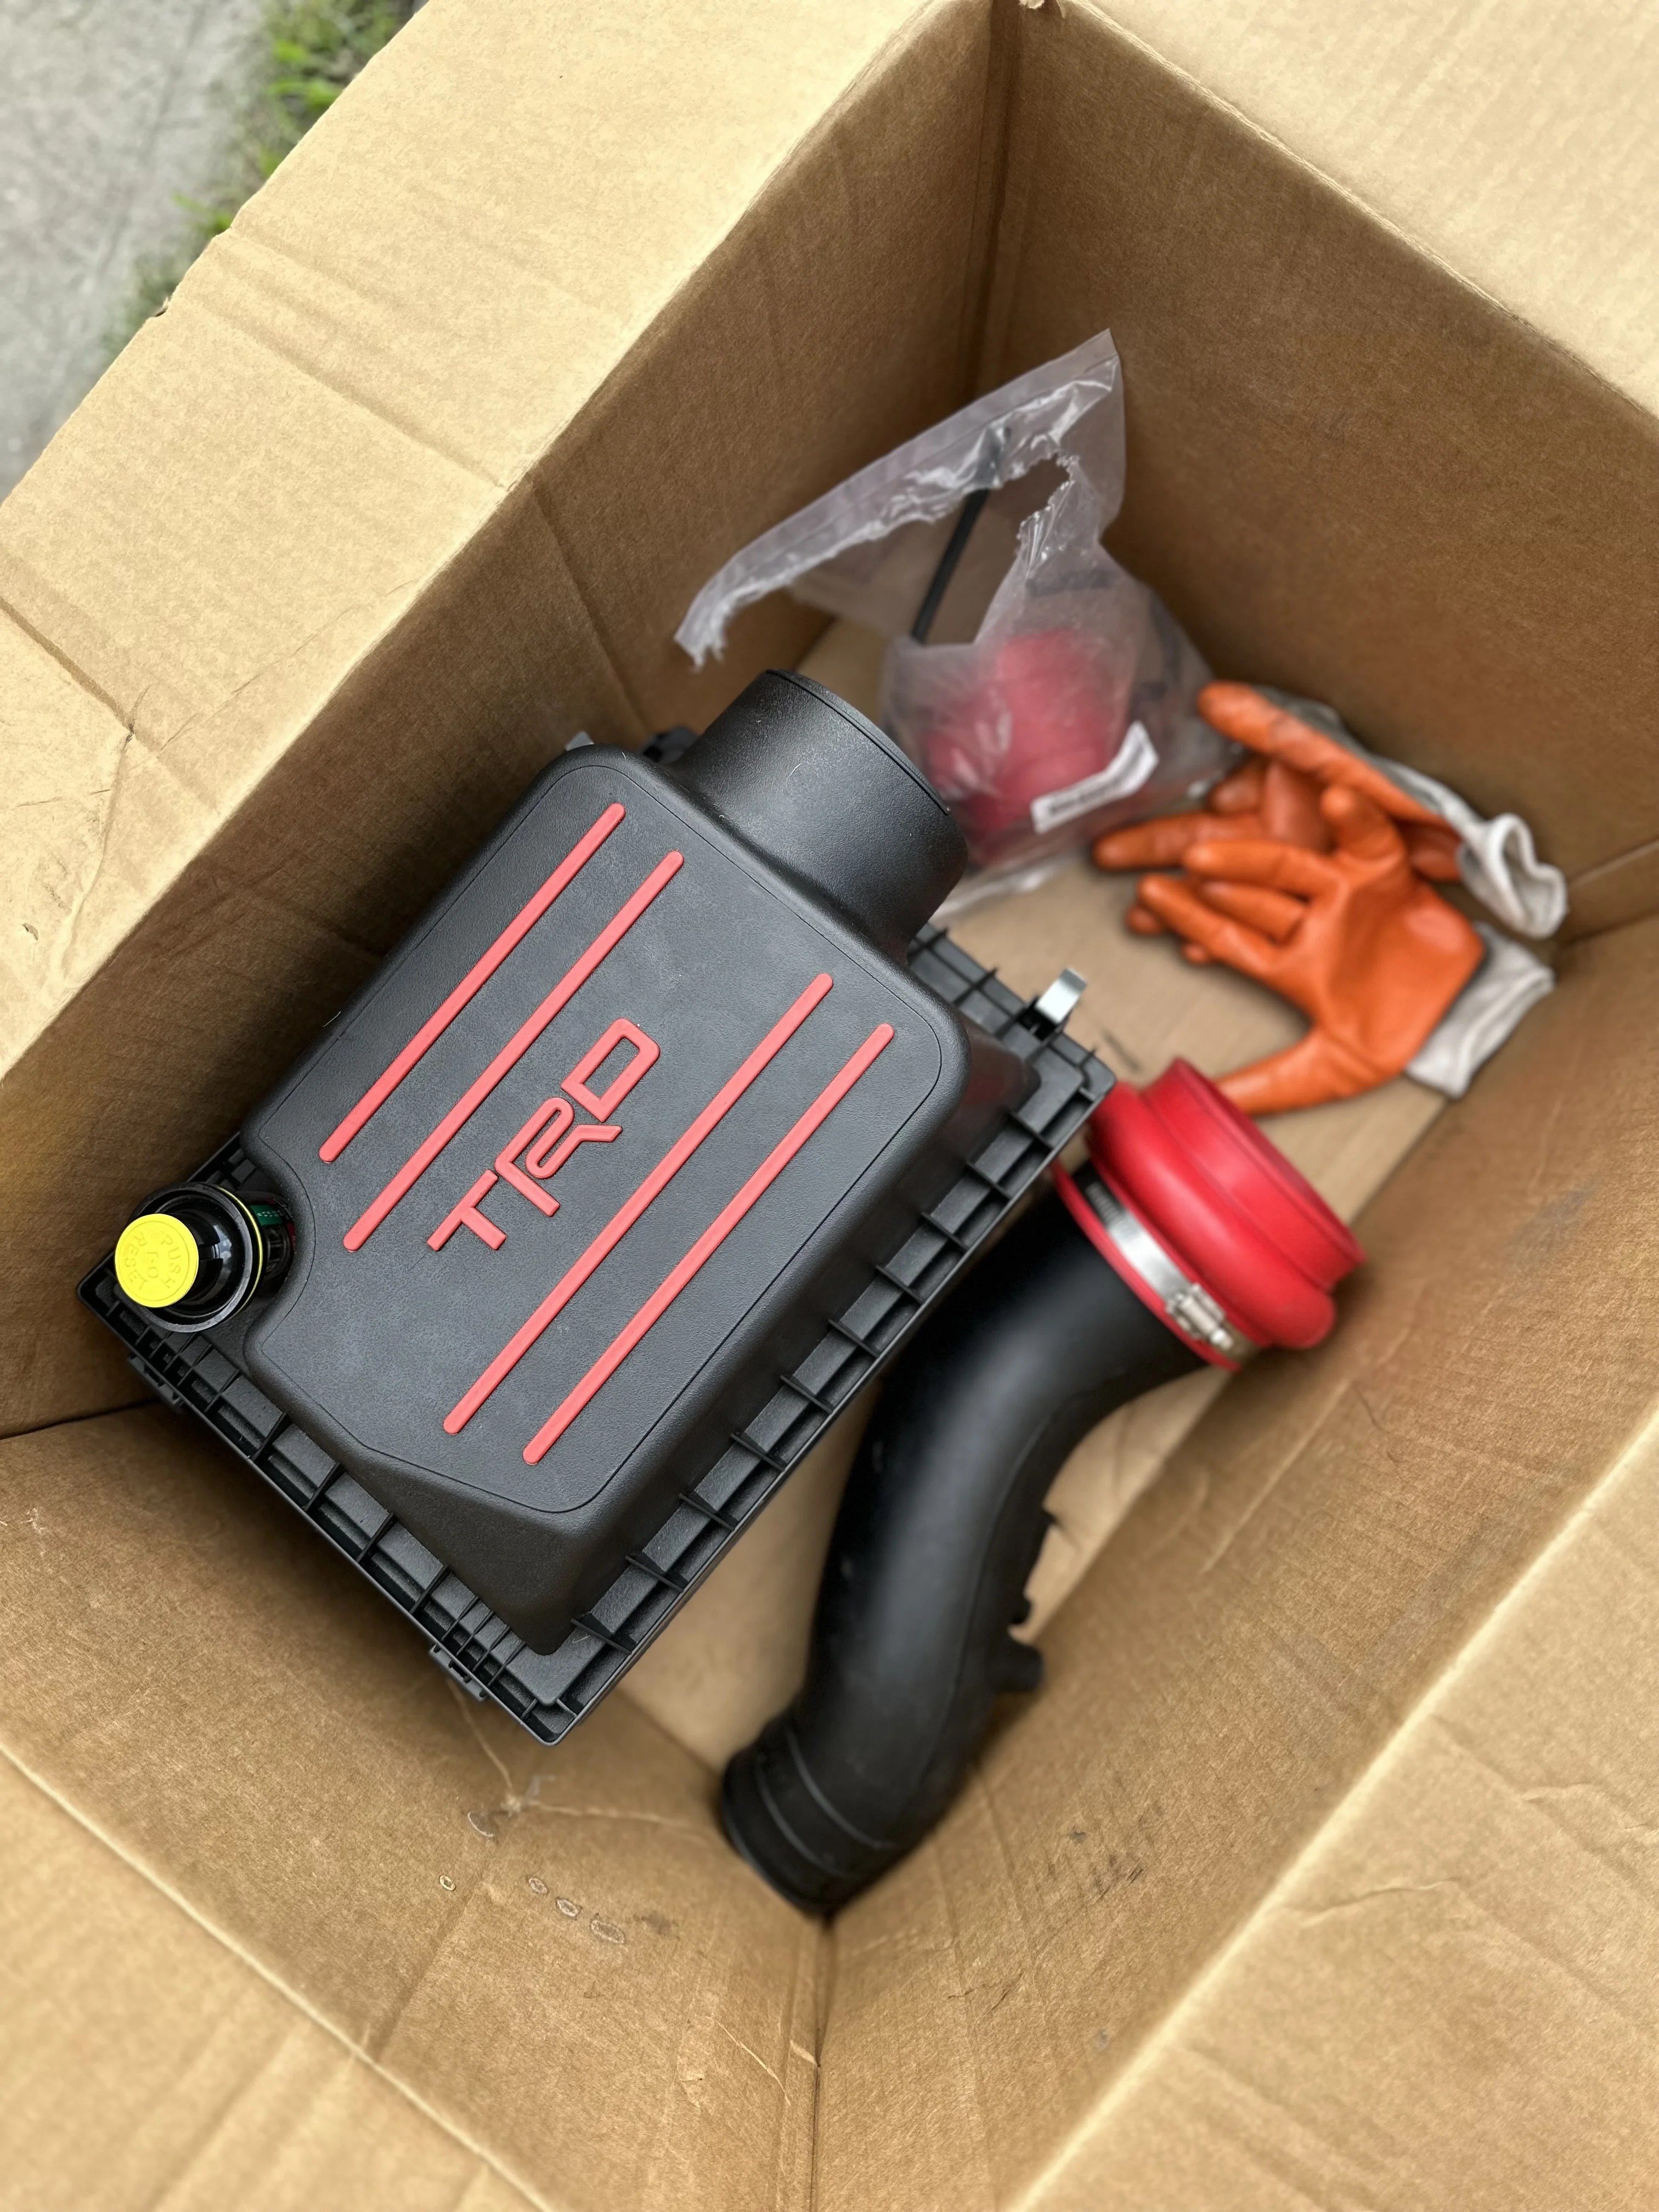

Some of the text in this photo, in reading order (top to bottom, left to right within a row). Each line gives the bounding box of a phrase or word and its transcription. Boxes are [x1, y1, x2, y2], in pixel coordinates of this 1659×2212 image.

[426, 1017, 661, 1251] TRD
[124, 1232, 149, 1290] RESET
[160, 1233, 181, 1289] PUSH
